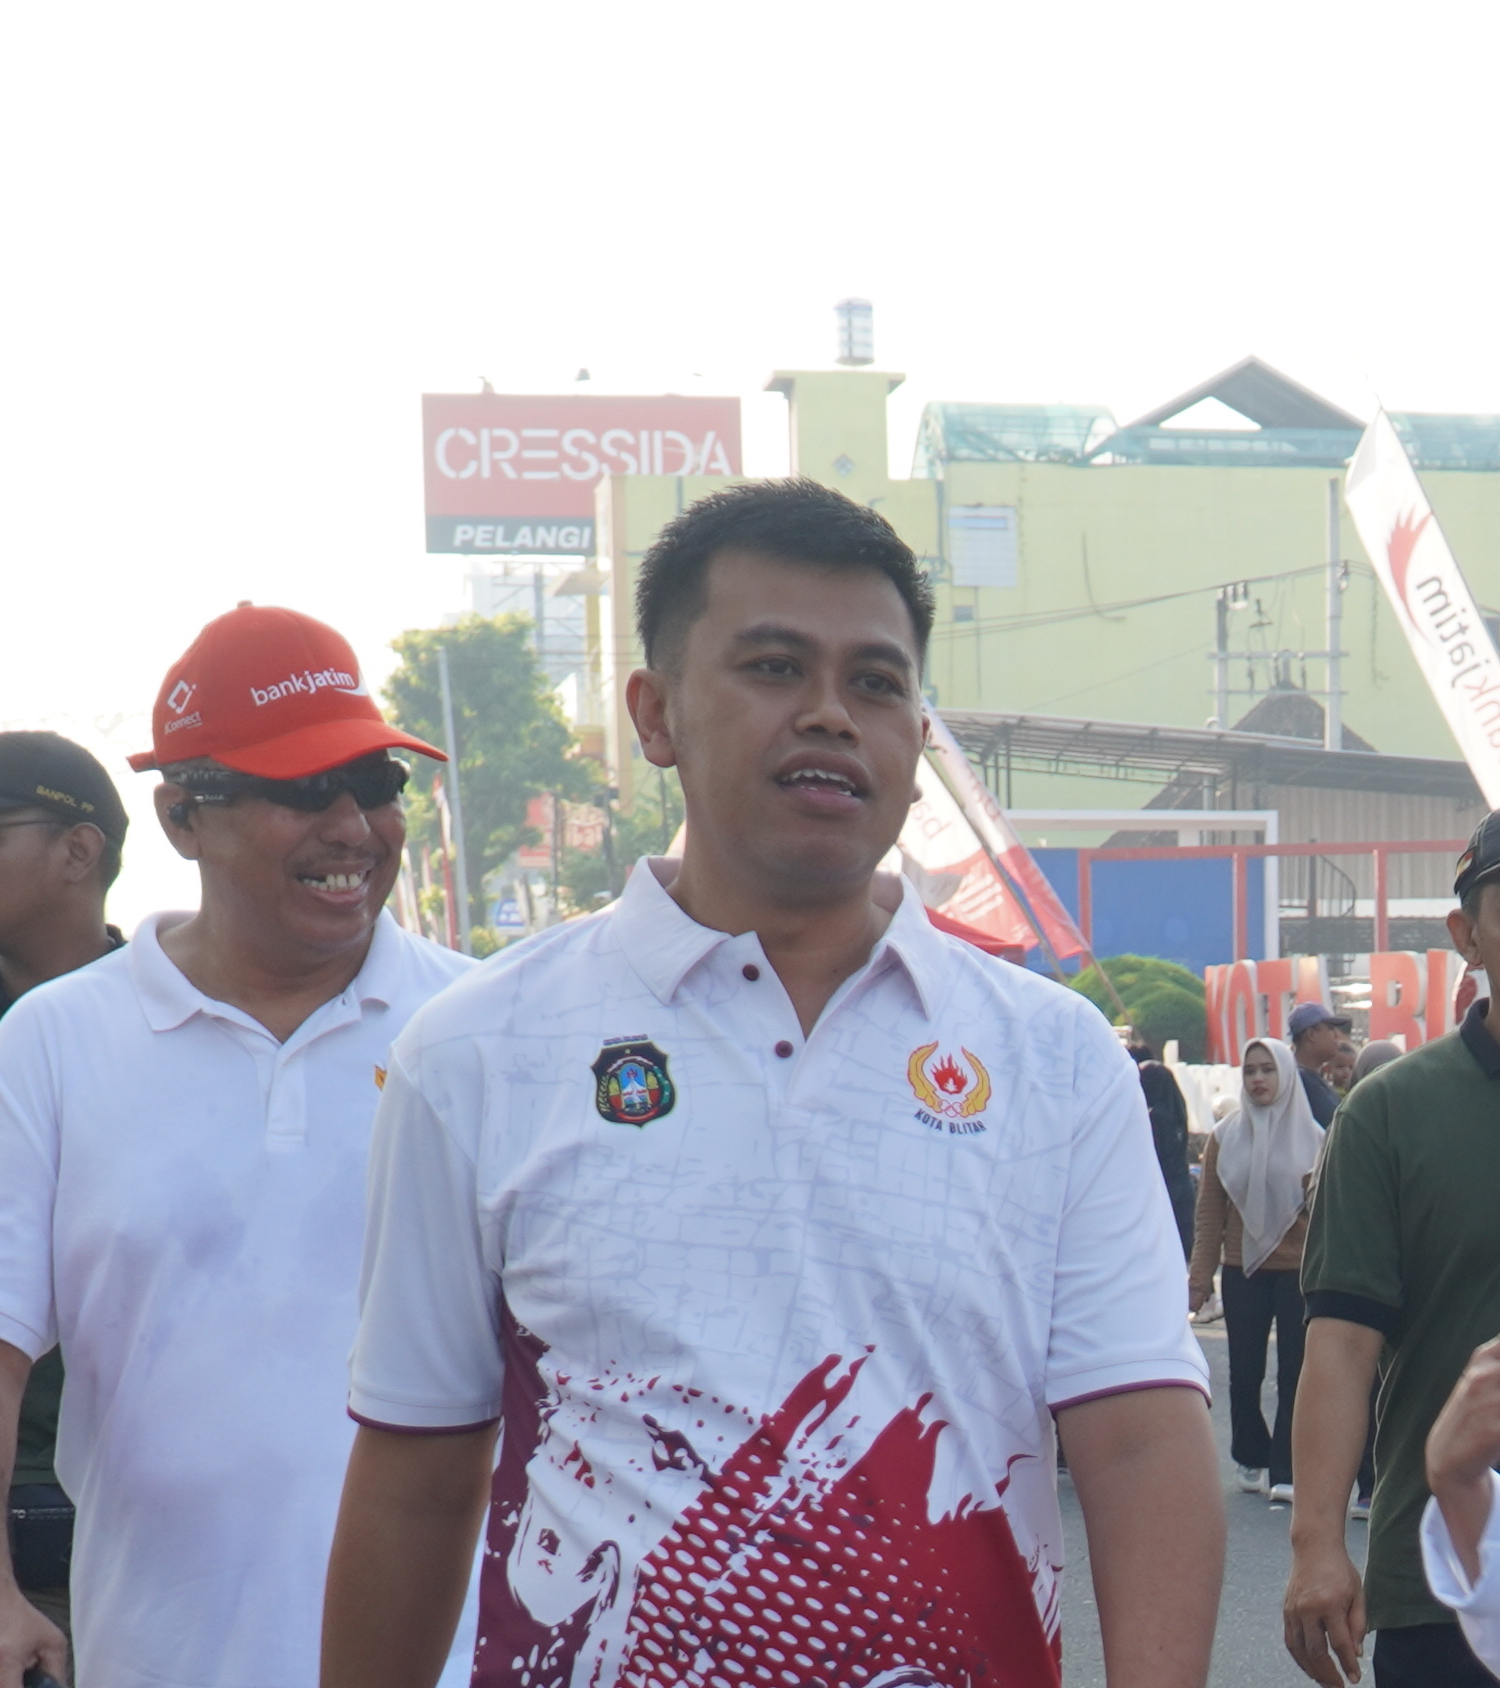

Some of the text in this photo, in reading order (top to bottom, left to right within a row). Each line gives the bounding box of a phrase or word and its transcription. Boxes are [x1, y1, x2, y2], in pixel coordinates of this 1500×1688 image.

[434, 427, 733, 480] CRESSIDA
[453, 524, 592, 549] PELANGI
[251, 667, 356, 706] bankjatim
[914, 1108, 987, 1135] KOTA BLITAR
